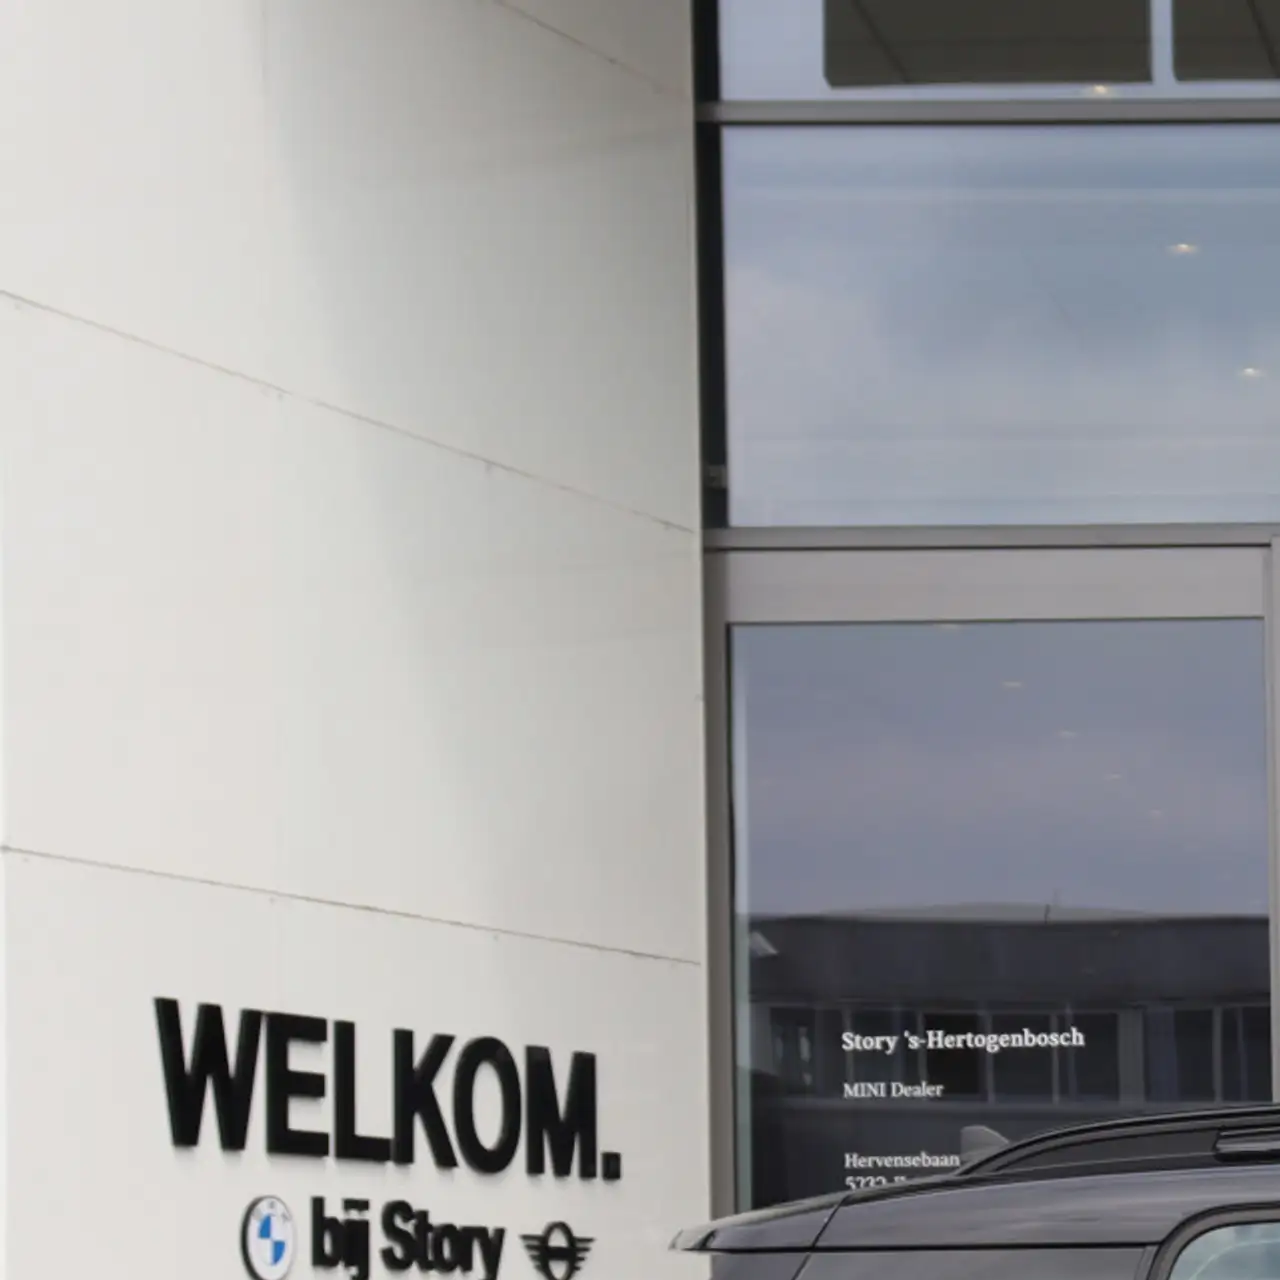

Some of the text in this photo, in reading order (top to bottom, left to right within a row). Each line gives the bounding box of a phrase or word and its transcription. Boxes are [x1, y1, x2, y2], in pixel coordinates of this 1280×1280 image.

[841, 1031, 899, 1054] Story
[154, 996, 621, 1180] WELKOM.
[843, 1081, 944, 1098] MINI Dealer
[844, 1151, 960, 1168] Hervensebaan
